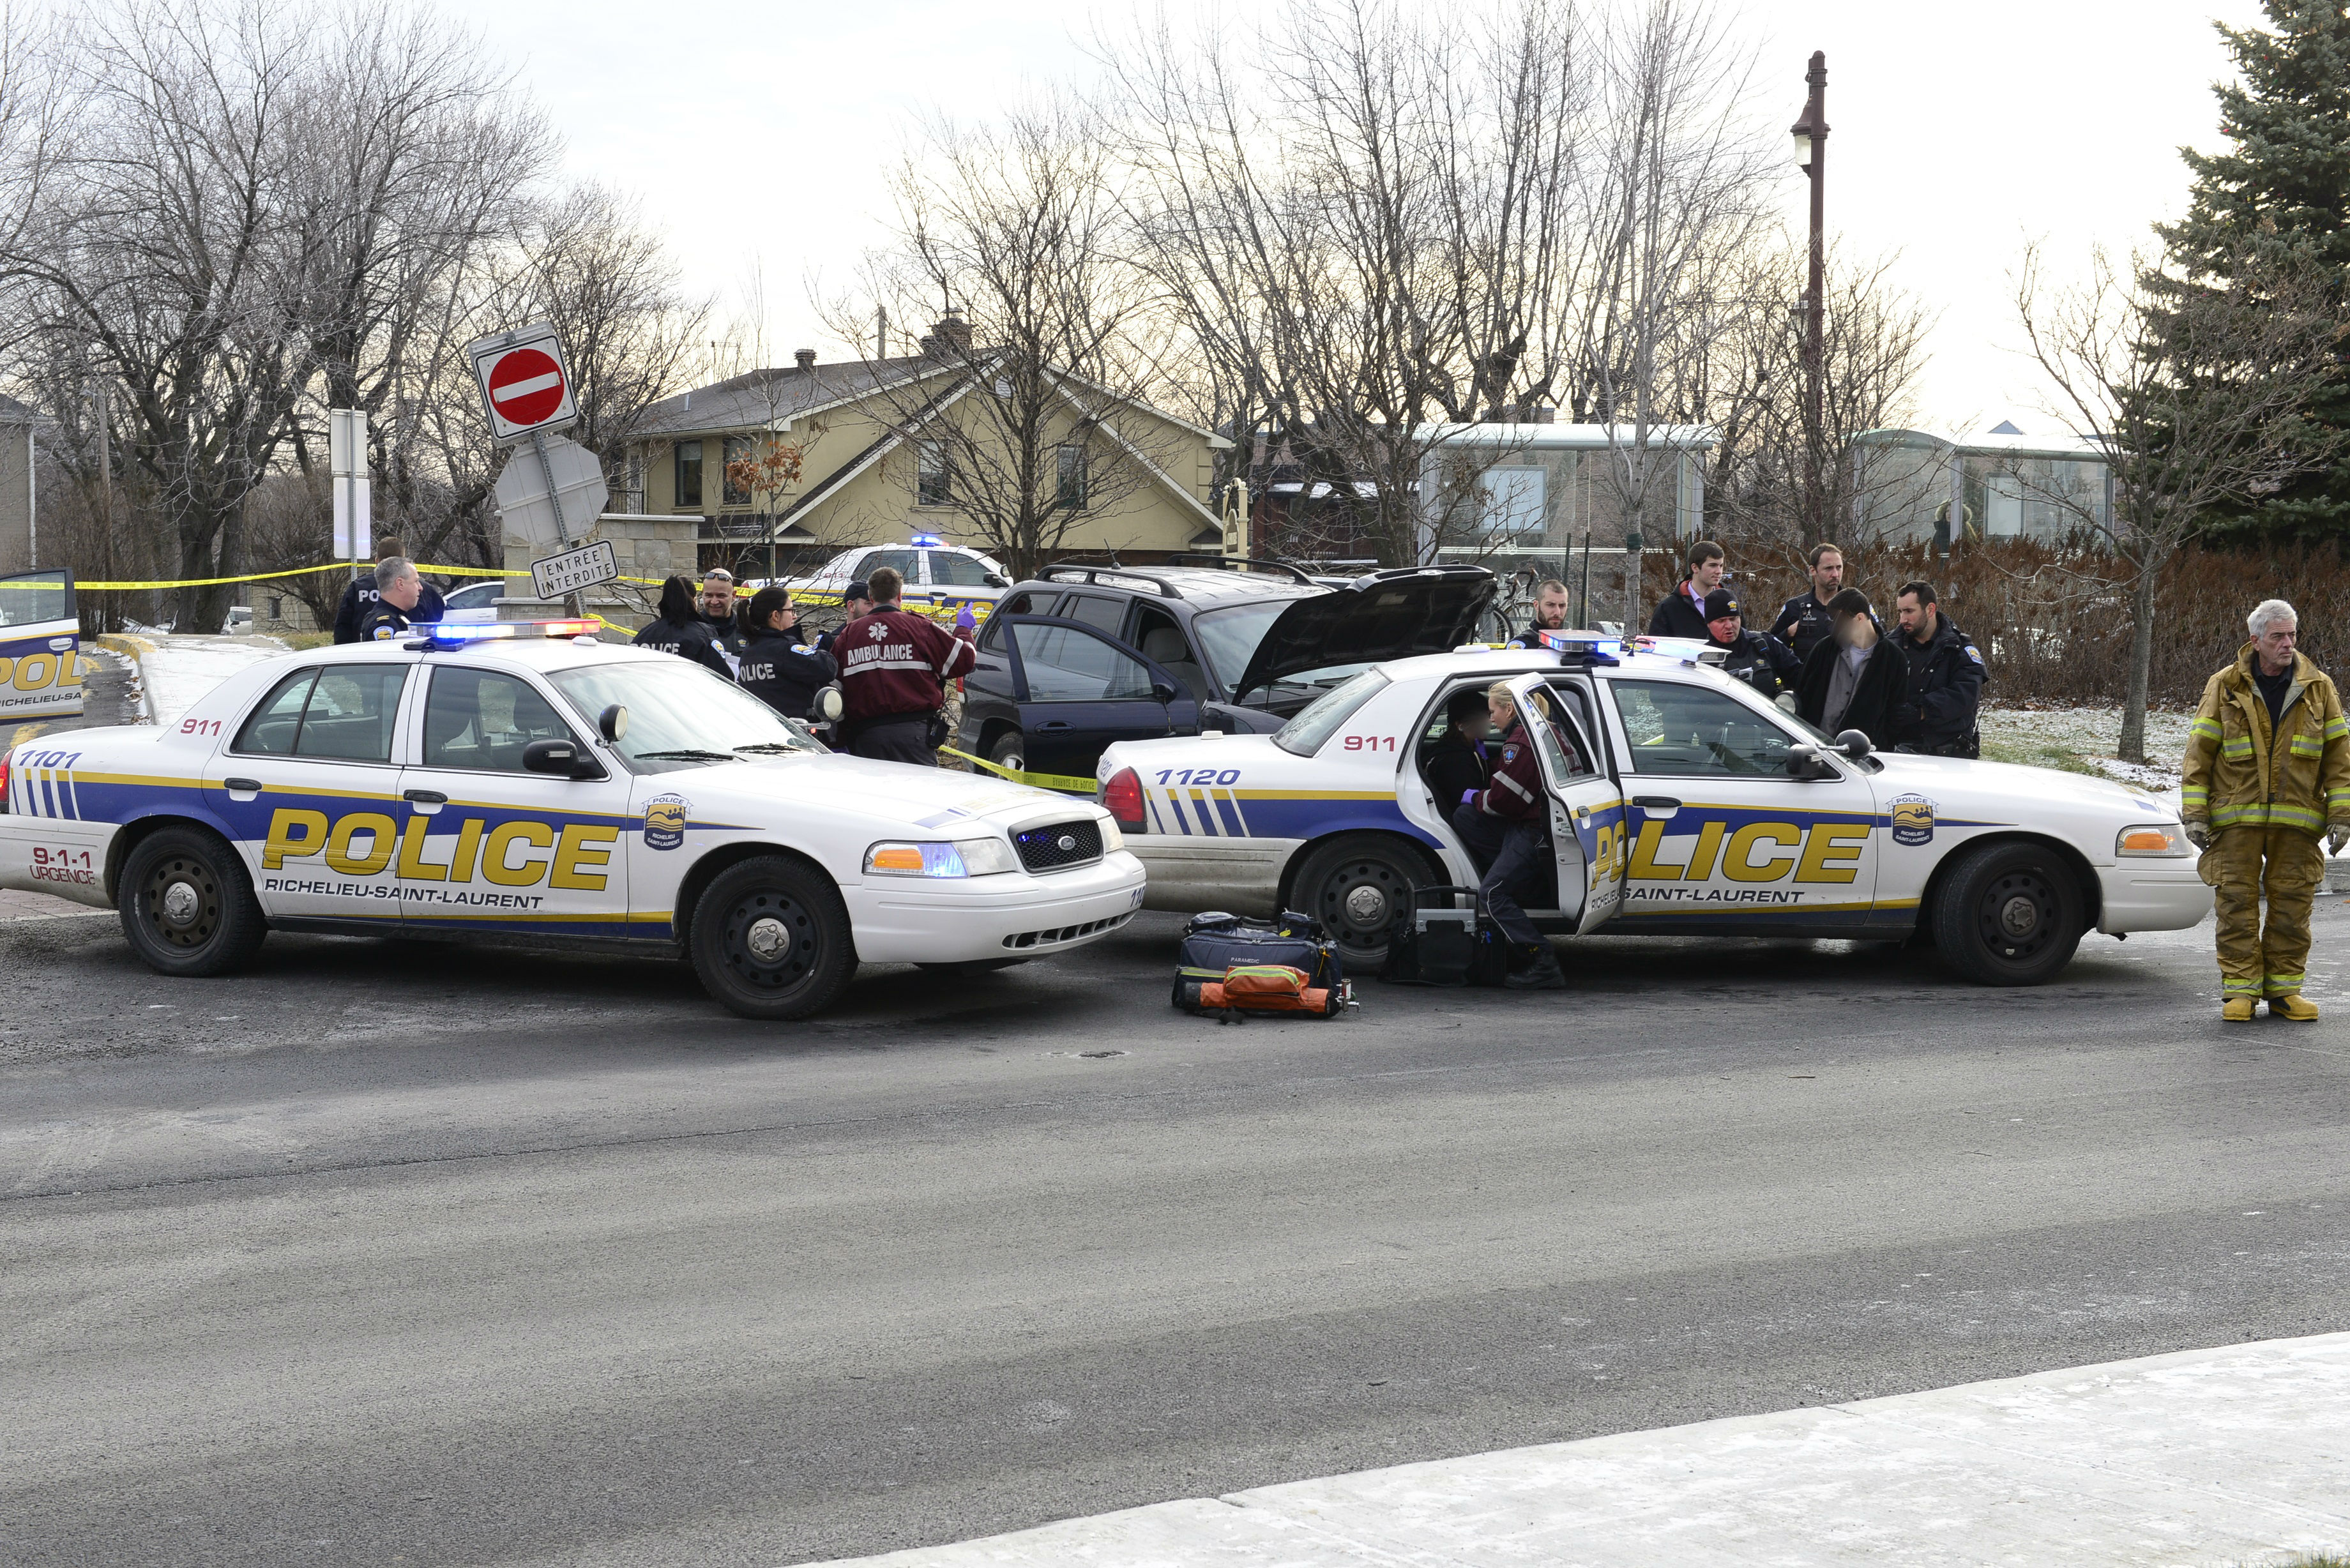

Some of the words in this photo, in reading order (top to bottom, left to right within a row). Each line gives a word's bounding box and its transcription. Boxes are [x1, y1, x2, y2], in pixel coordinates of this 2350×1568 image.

[546, 550, 600, 576] ENTRÉE
[542, 563, 612, 594] INTERDITE
[847, 644, 913, 665] AMBULANCE
[0, 692, 82, 707] ICHELIEU-SA
[180, 718, 222, 736] 911
[1344, 735, 1395, 752] 911
[19, 750, 82, 769] 1101
[1155, 769, 1241, 785] 1120
[653, 797, 685, 805] POLICE
[261, 808, 621, 891] POLICE
[647, 837, 680, 847] SAINT-LAURENT
[33, 847, 91, 869] 9-1-1
[29, 864, 95, 885] URGENCE
[264, 878, 543, 909] RICHELIEU-SAINT-LAURENT
